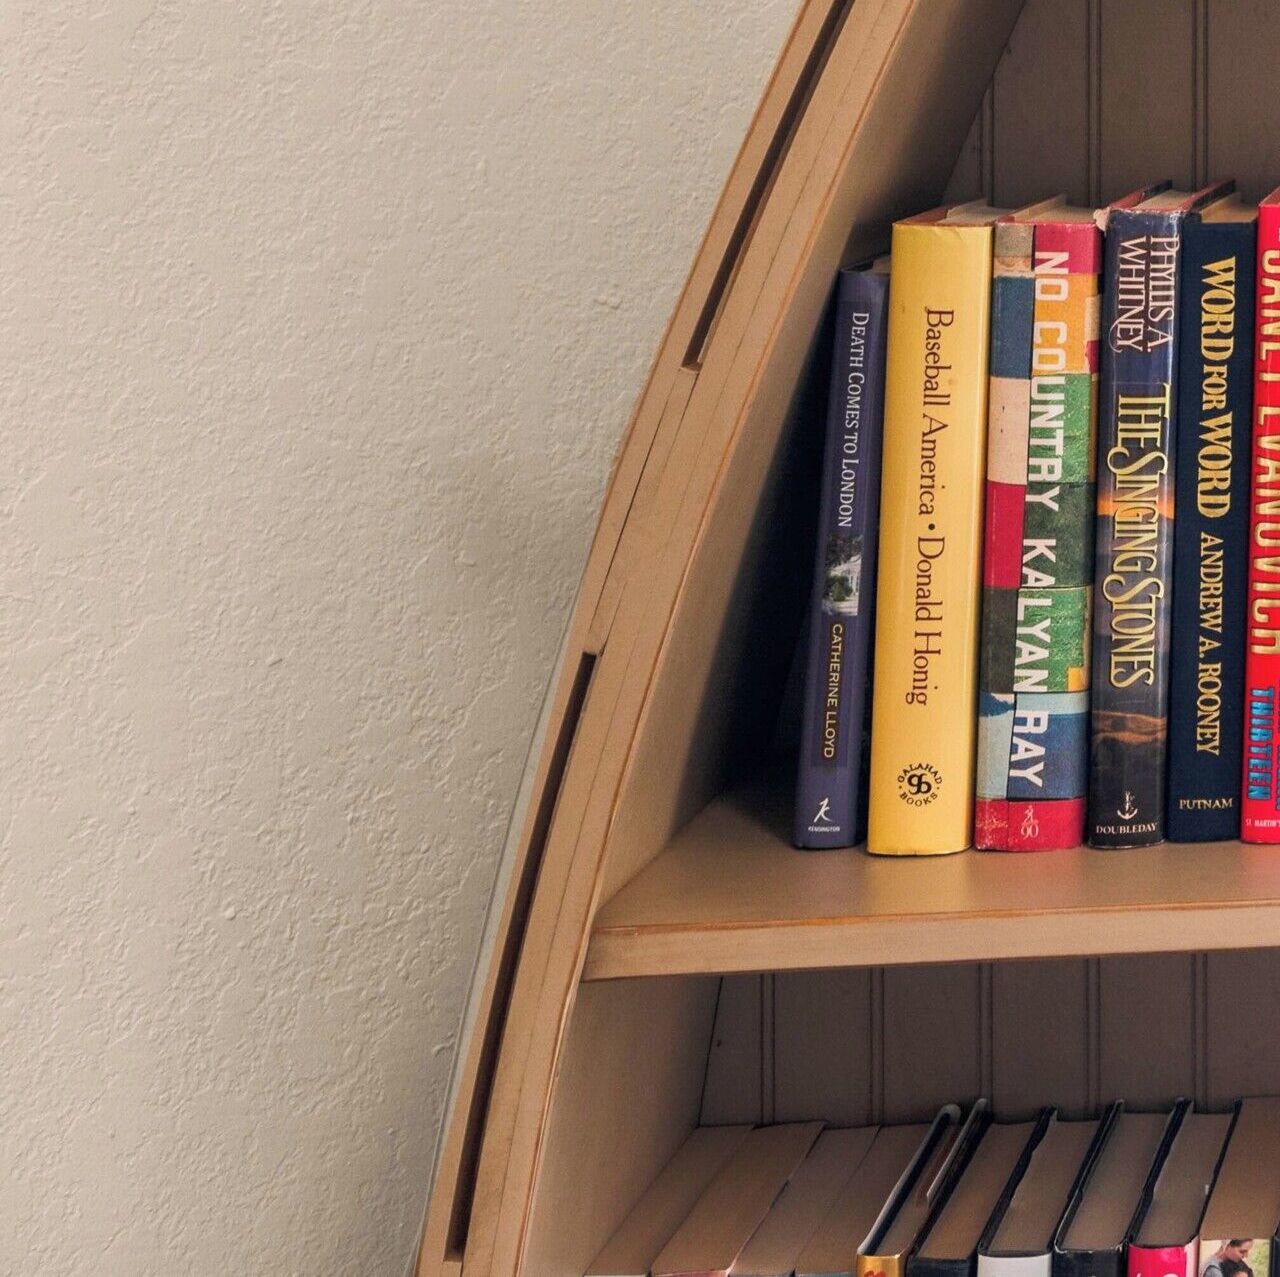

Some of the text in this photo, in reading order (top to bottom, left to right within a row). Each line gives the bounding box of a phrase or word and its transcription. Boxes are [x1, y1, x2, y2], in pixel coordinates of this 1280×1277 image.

[1109, 235, 1147, 354] WHITNEY
[1147, 234, 1179, 353] PHYLLIS A.
[838, 311, 869, 528] DEATH COMES TO LONDON
[1197, 256, 1236, 519] WORD FOR WORD
[906, 306, 954, 707] Baseball America Donald Honig
[1009, 251, 1070, 788] NO COUNTRY KALYAN RAY
[1102, 383, 1171, 689] THE SINGING STONES
[823, 623, 843, 759] CATHERINE LLOYD
[1196, 531, 1223, 757] ANDREW A. ROONEY
[897, 763, 943, 785] GALAHAD
[900, 791, 938, 808] BOOKS
[1179, 797, 1233, 811] PUTNAM
[1247, 686, 1275, 800] THIRTEEN
[1096, 822, 1158, 835] DOUBLEDAY
